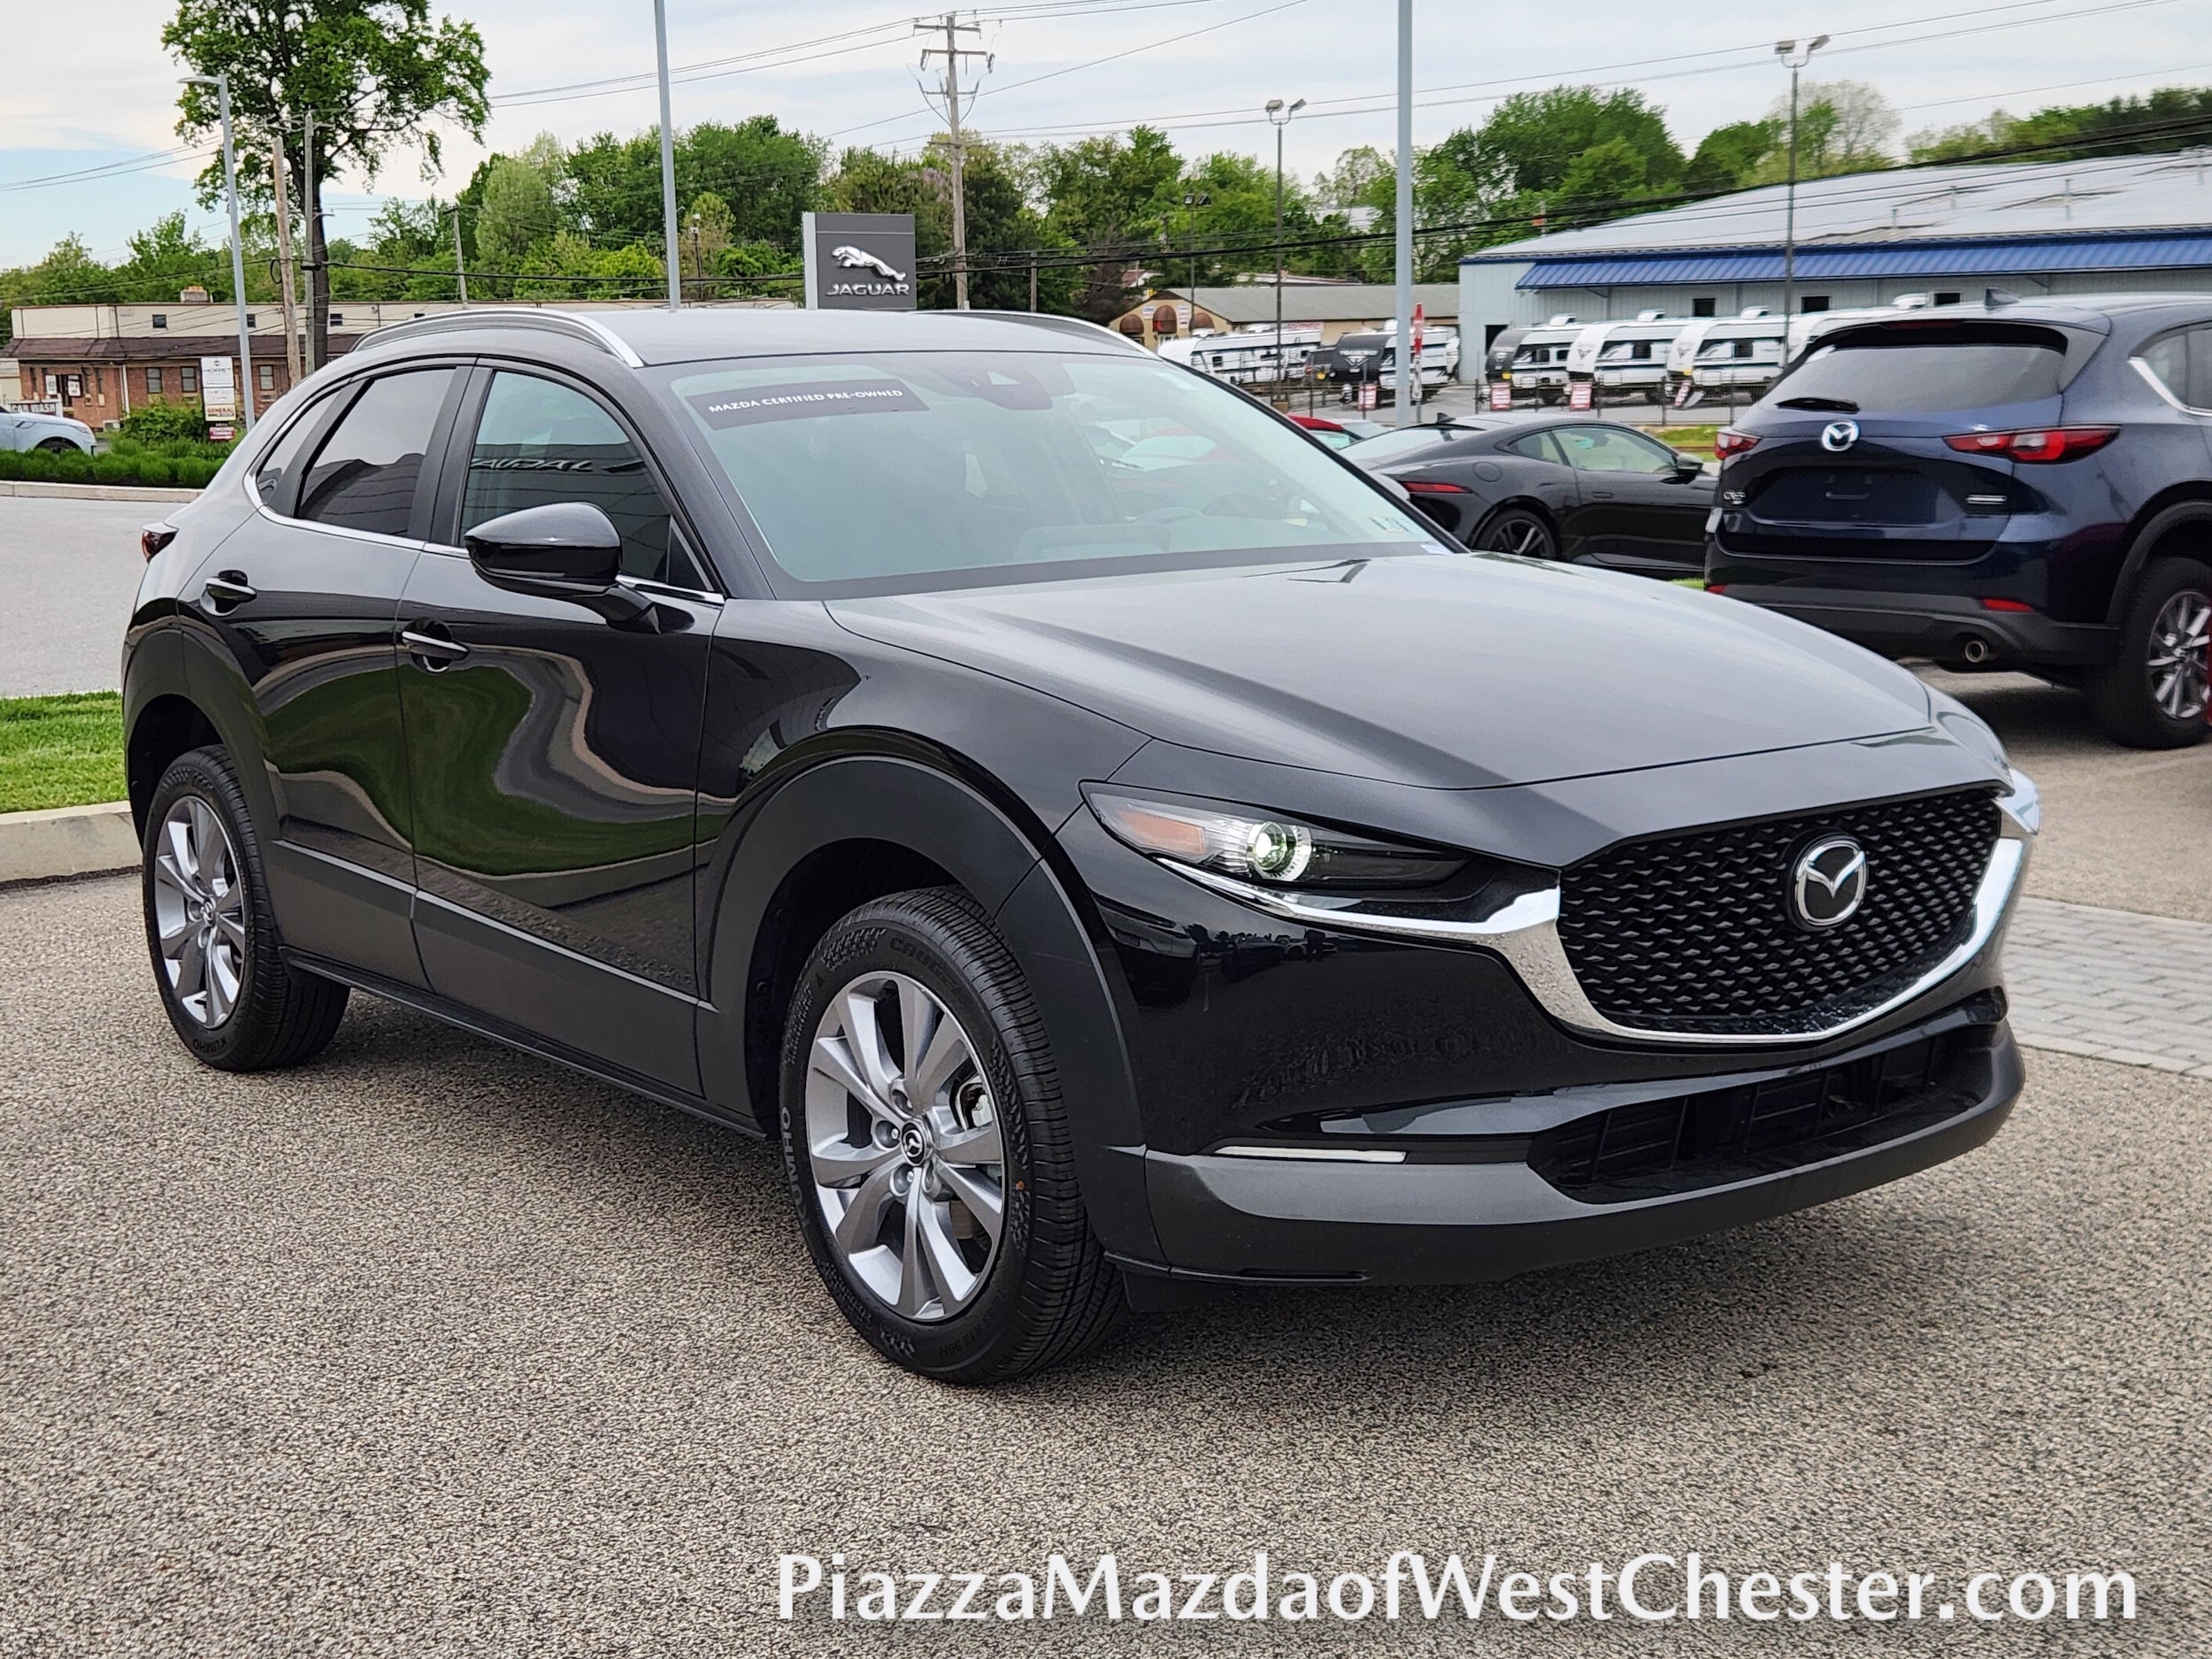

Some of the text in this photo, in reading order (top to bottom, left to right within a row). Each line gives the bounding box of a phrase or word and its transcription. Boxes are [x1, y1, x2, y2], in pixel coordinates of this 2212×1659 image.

[826, 282, 910, 296] JAGUAR
[12, 403, 56, 413] CAR WASH
[708, 389, 904, 413] MAZDA CERTIFIED PRE-OWNED
[781, 1106, 810, 1228] KUMHO
